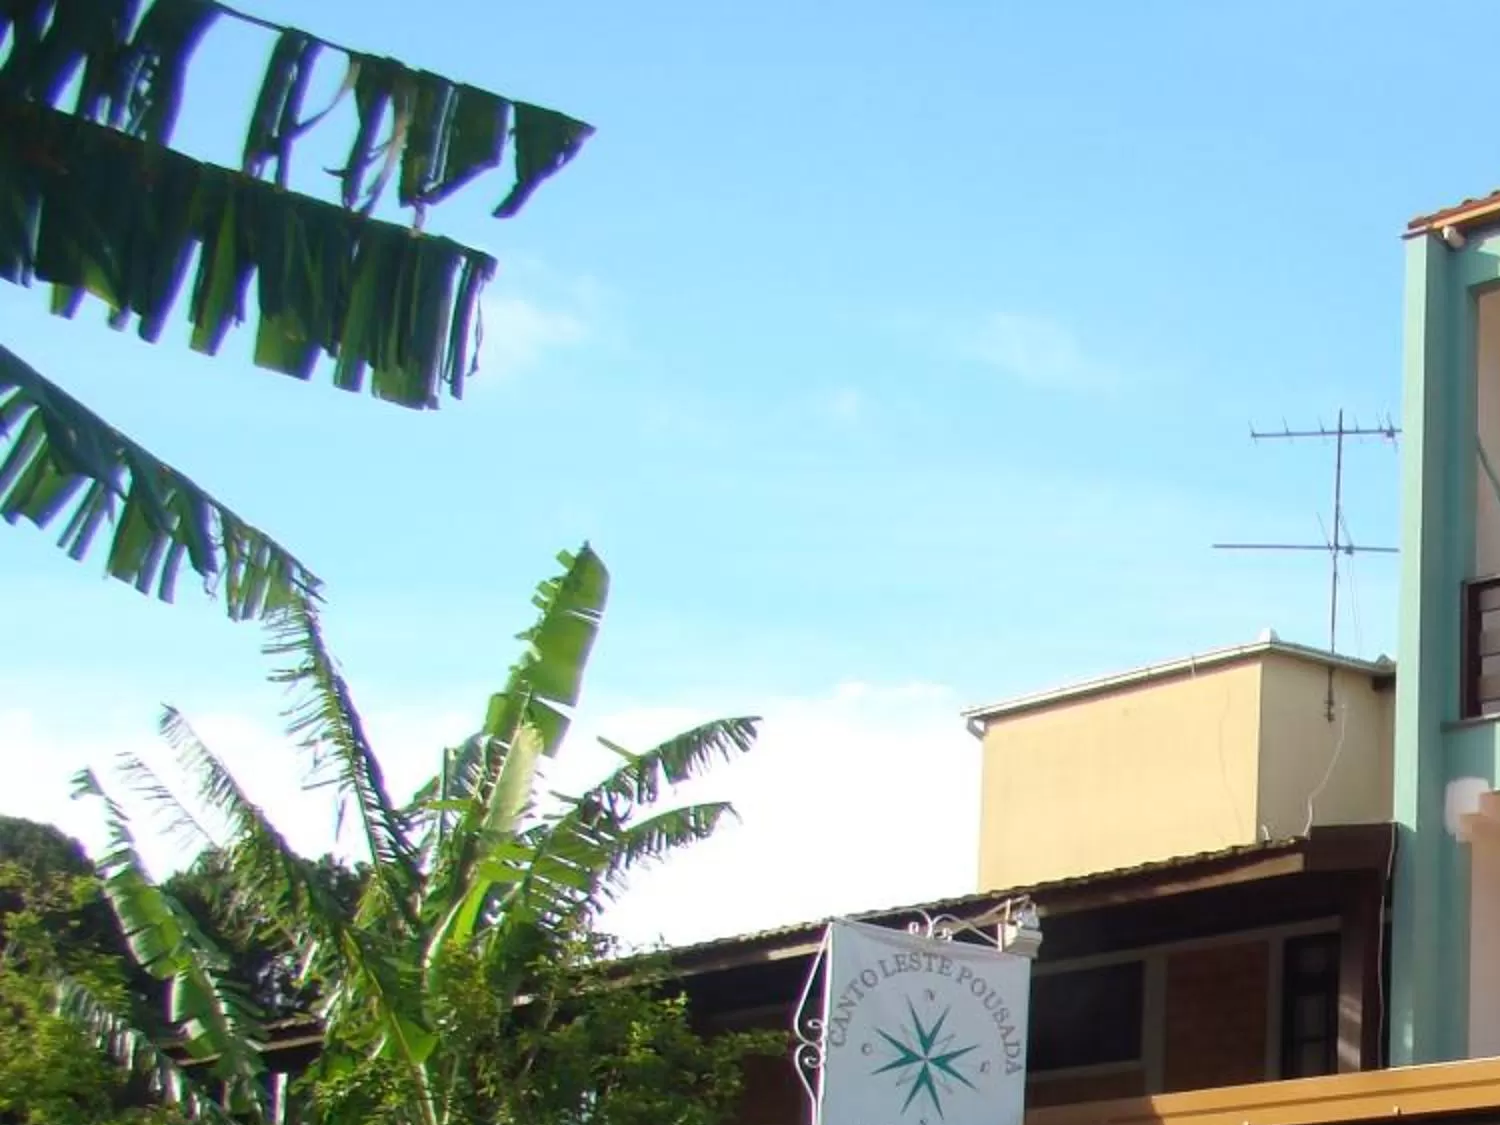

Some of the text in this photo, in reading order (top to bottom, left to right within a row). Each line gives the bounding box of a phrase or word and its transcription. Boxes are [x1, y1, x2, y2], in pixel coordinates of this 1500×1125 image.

[828, 951, 1024, 1076] CANTO LESTE POUSADA
